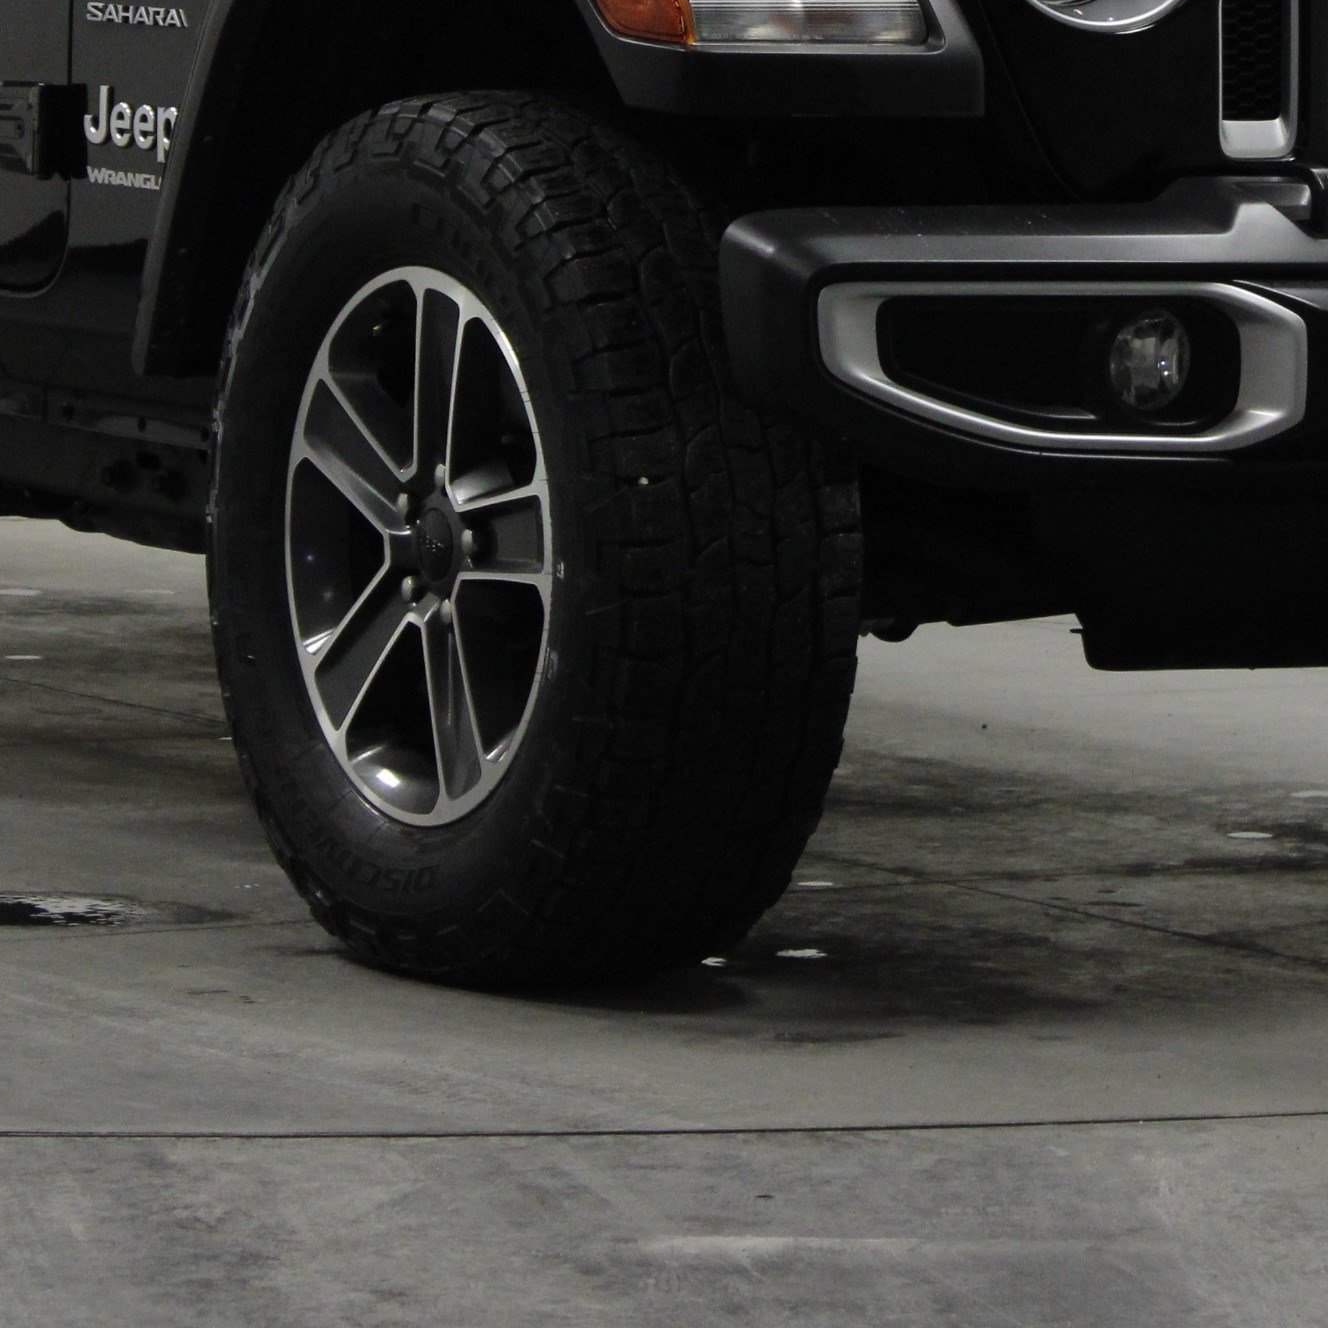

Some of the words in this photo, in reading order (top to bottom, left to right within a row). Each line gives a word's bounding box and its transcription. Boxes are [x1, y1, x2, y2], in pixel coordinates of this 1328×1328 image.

[86, 2, 189, 27] SAHARA
[83, 84, 178, 163] Jeep
[86, 166, 163, 190] WRANGL
